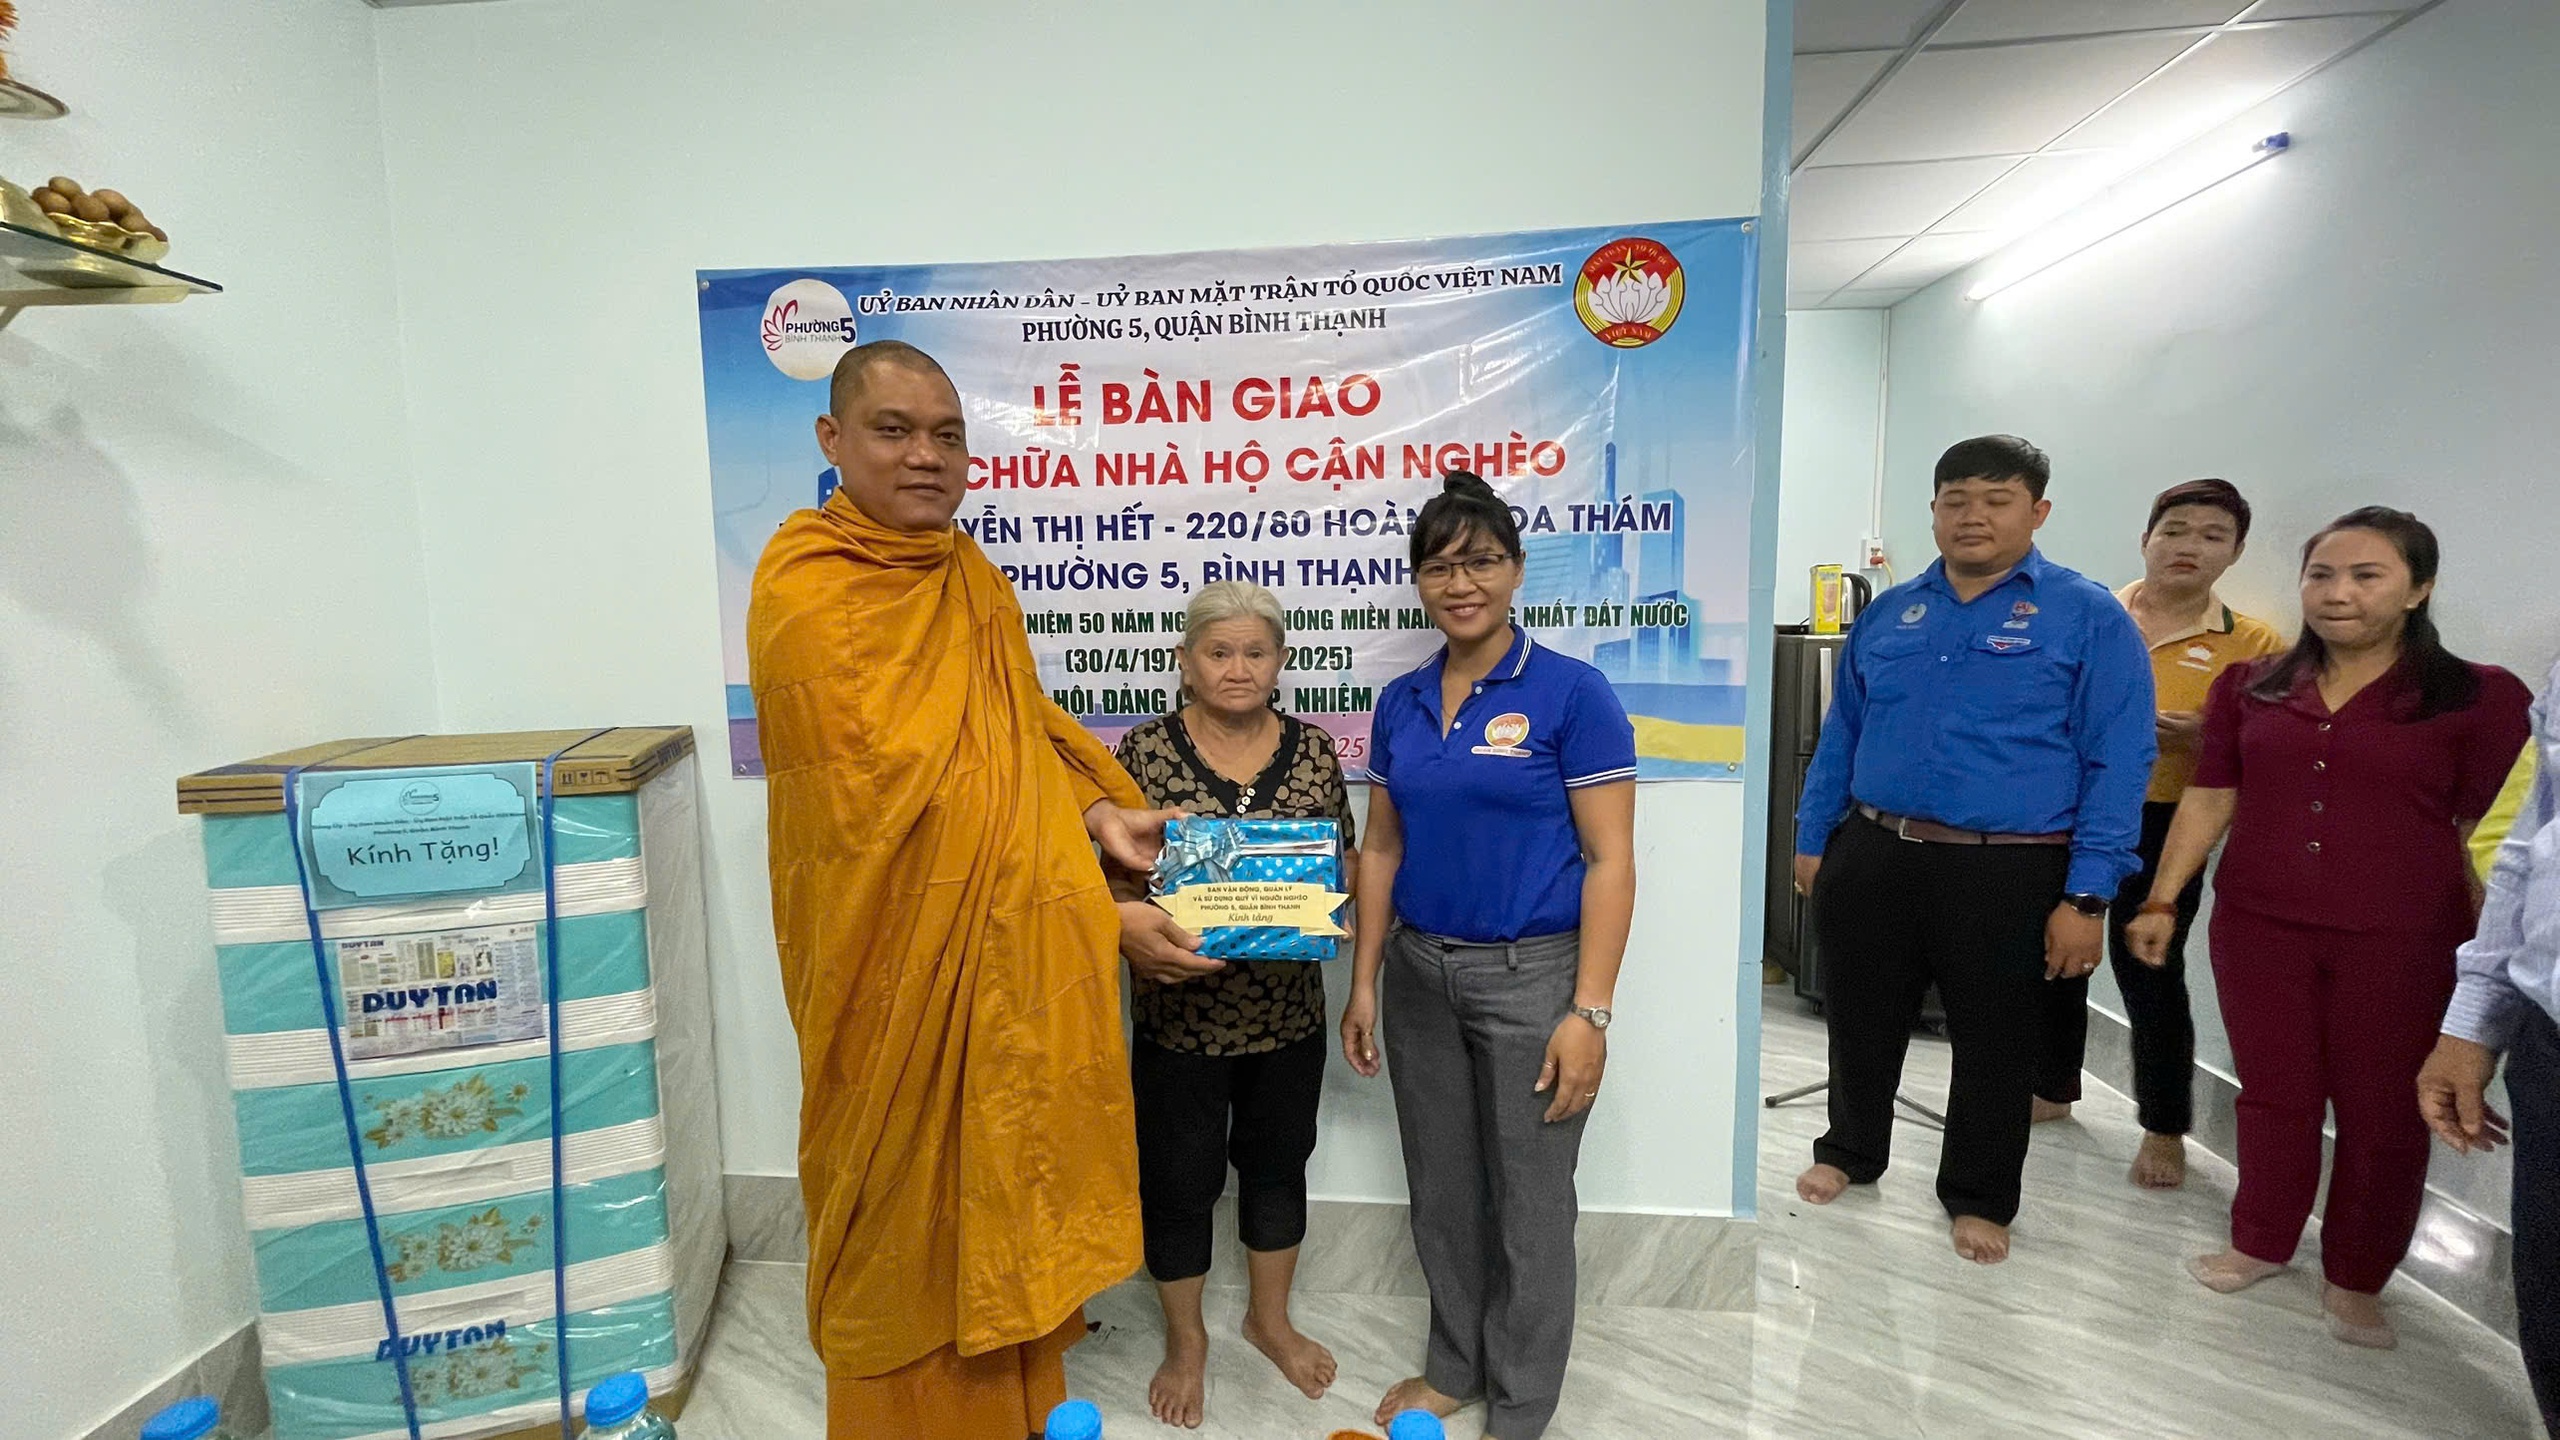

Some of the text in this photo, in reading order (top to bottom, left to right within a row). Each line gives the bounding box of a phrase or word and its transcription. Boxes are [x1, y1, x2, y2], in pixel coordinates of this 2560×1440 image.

[896, 296, 946, 312] BAN
[949, 289, 1019, 310] NHÂN
[1025, 288, 1075, 308] DÂN
[1134, 289, 1184, 306] BAN
[1190, 280, 1245, 306] MẶT
[1250, 275, 1318, 302] TRẬN
[1323, 269, 1357, 296] TỔ
[1434, 266, 1494, 294] VIỆT
[1501, 264, 1562, 285] NAM
[785, 317, 856, 343] PHƯỜNG 5
[1022, 307, 1387, 343] PHƯỜNG 5, QUẬN BÌNH THẠNH
[1033, 363, 1382, 426] LỄ BÀN GIAO
[966, 430, 1566, 493] CHỮA NHÀ HỘ CẬN NGHÈO
[1032, 514, 1084, 550] THỊ
[1096, 501, 1155, 541] HẾT
[1186, 510, 1311, 542] 220/80
[1567, 495, 1671, 532] THÁM
[1001, 552, 1417, 594] PHƯỜNG 5, BÌNH THẠNH
[1026, 609, 1073, 638] NIỆM
[1079, 613, 1105, 634] 50
[1112, 609, 1154, 633] NĂM
[1341, 601, 1390, 631] MIỀN
[1522, 598, 1577, 628] NHẤT
[1583, 598, 1624, 628] ĐẤT
[1630, 599, 1688, 628] NƯỚC
[1065, 648, 1182, 673] (30/4/197
[1053, 684, 1094, 719] HỘI
[1102, 682, 1167, 714] ĐẢNG
[1295, 682, 1372, 717] NHIỆM
[347, 837, 499, 866] Kính Tặng!
[362, 979, 498, 1014] DUYTAN
